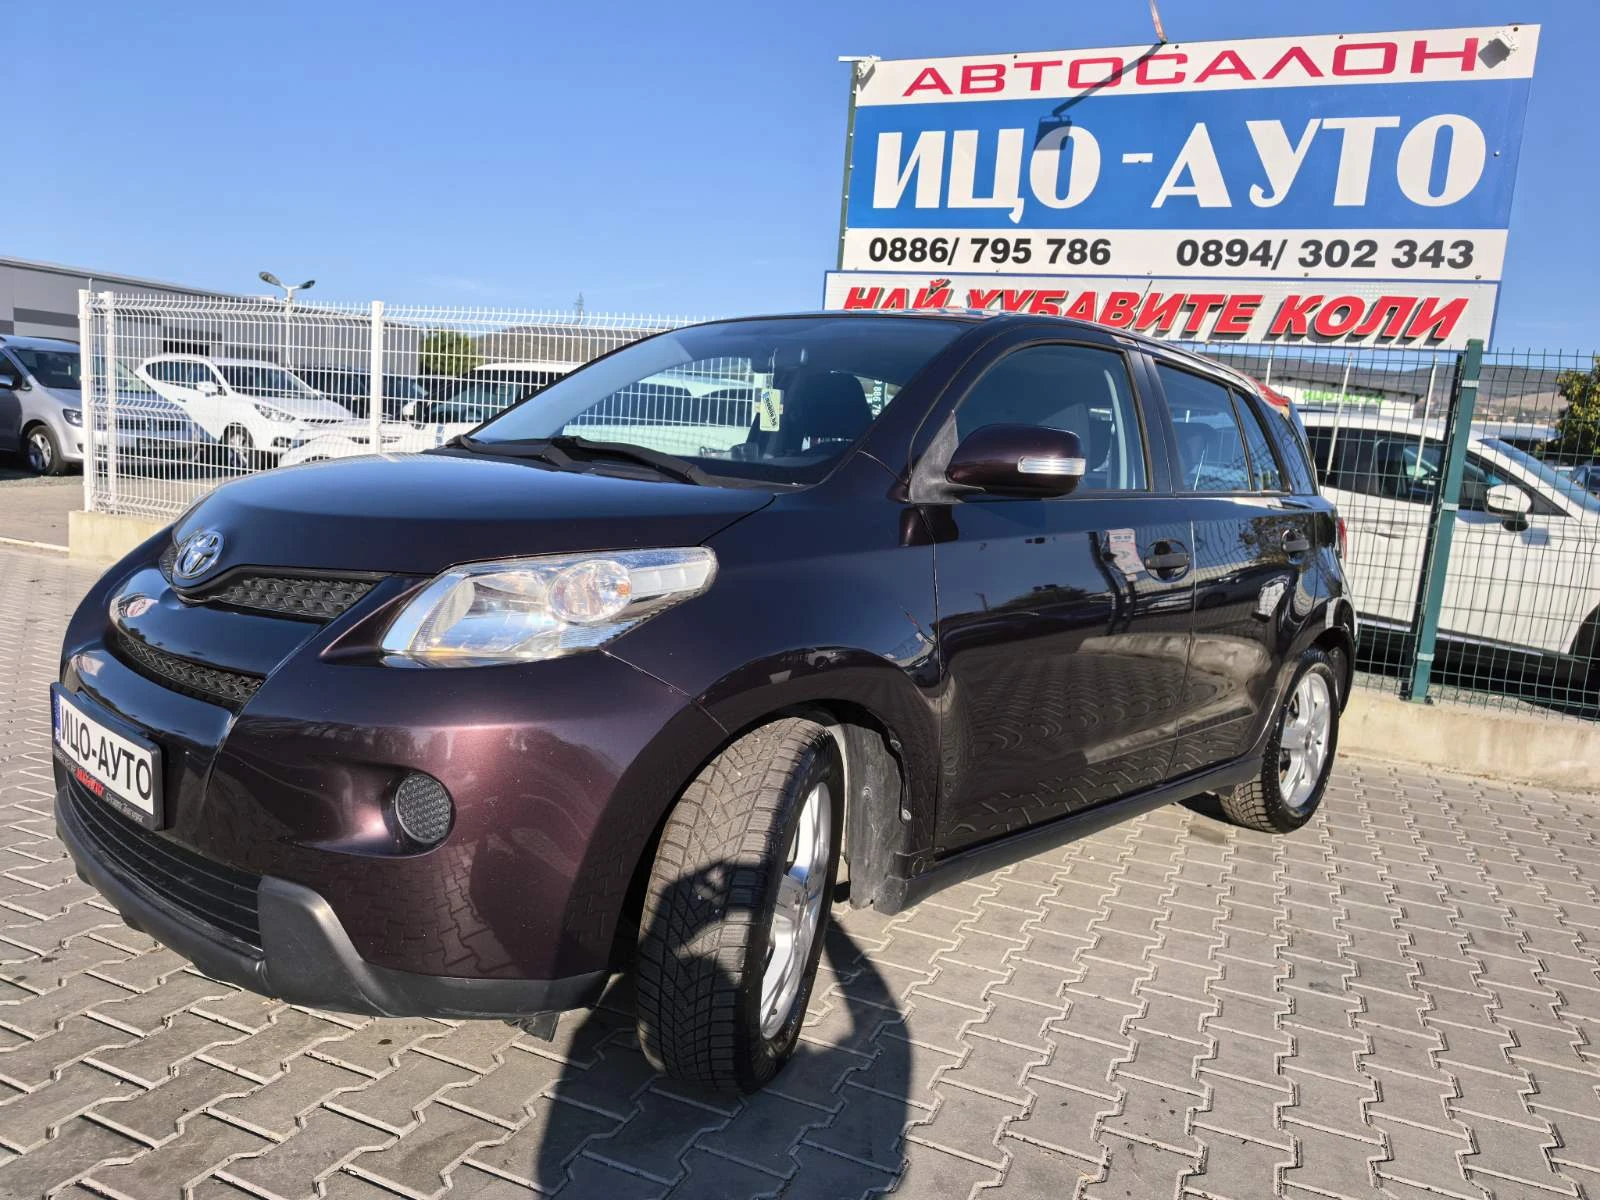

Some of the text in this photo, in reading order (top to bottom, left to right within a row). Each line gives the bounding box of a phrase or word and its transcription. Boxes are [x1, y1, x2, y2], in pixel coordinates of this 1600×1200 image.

[903, 37, 1479, 97] АВТОСАЛОН
[868, 236, 1475, 271] 0886/ 795 786 0894/ 302 343
[966, 288, 1264, 333] ХУБАВИТЕ
[1270, 294, 1470, 339] КОЛИ
[61, 704, 152, 801] ИЦО-АУТО
